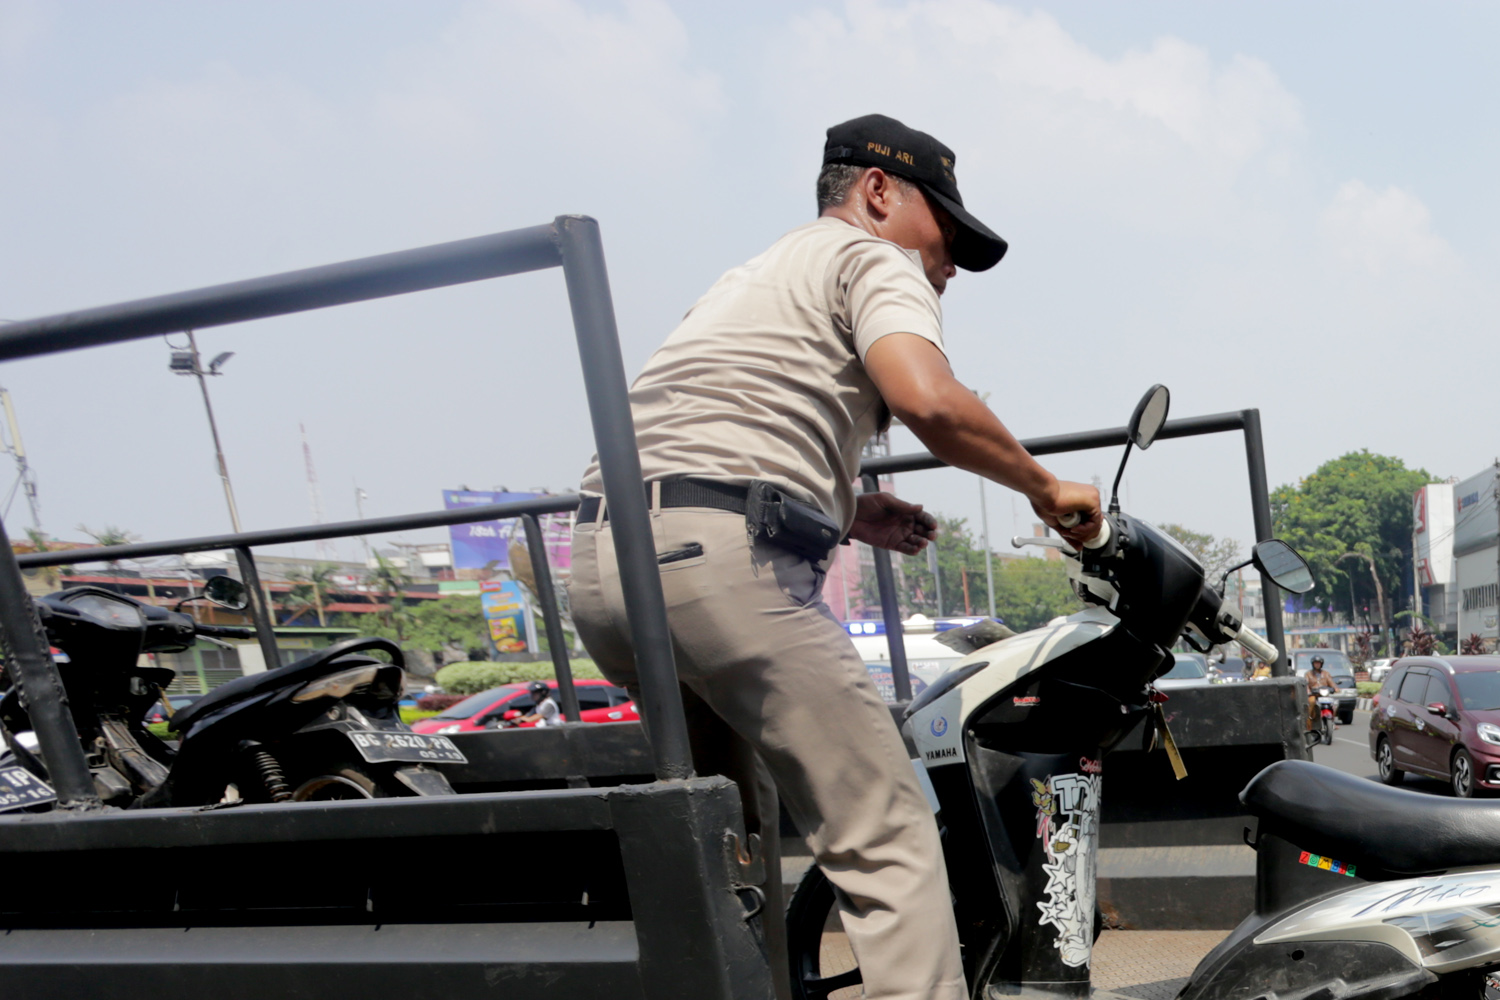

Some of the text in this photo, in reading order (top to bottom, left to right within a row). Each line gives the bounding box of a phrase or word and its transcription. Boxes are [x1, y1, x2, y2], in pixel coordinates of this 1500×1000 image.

[866, 142, 891, 157] PUJI
[353, 733, 381, 748] BG
[384, 734, 427, 749] 2620
[925, 747, 957, 761] YAMAHA
[1352, 884, 1491, 919] Mio
